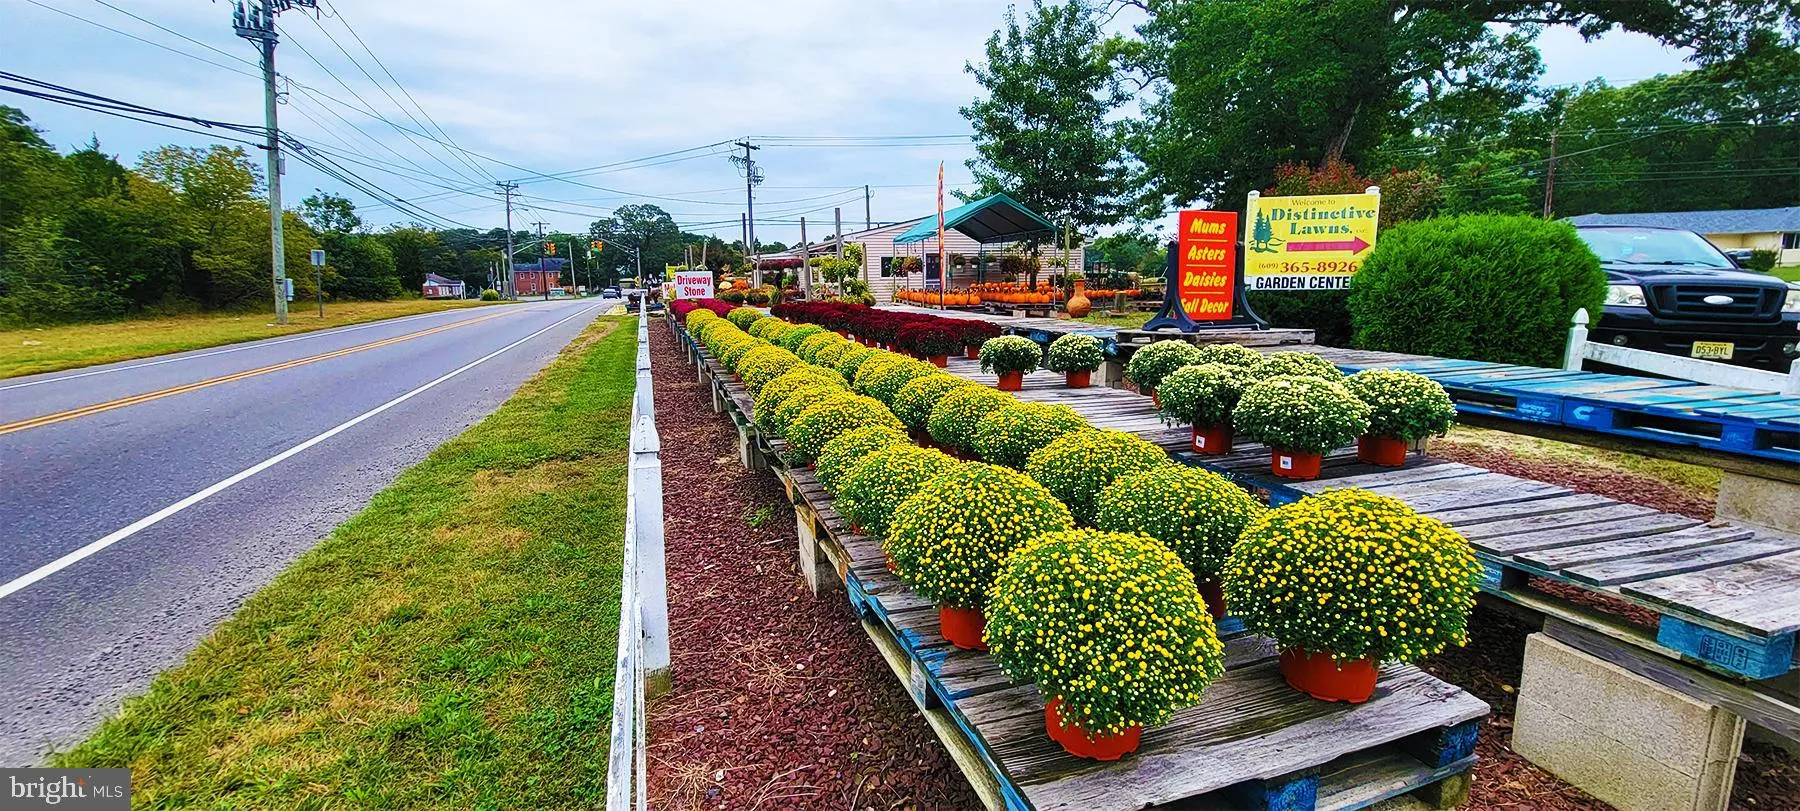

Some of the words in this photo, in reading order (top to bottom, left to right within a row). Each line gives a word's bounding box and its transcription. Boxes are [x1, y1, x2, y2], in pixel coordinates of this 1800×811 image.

[1271, 206, 1376, 221] Distinctive
[1190, 218, 1226, 234] Mums
[1187, 245, 1226, 261] Asters
[1280, 261, 1358, 273] 365-8926
[677, 275, 711, 286] Driveway
[1183, 271, 1227, 287] Daisies
[1256, 276, 1306, 289] GARDEN
[684, 286, 705, 296] Stone
[1199, 298, 1229, 312] Decor
